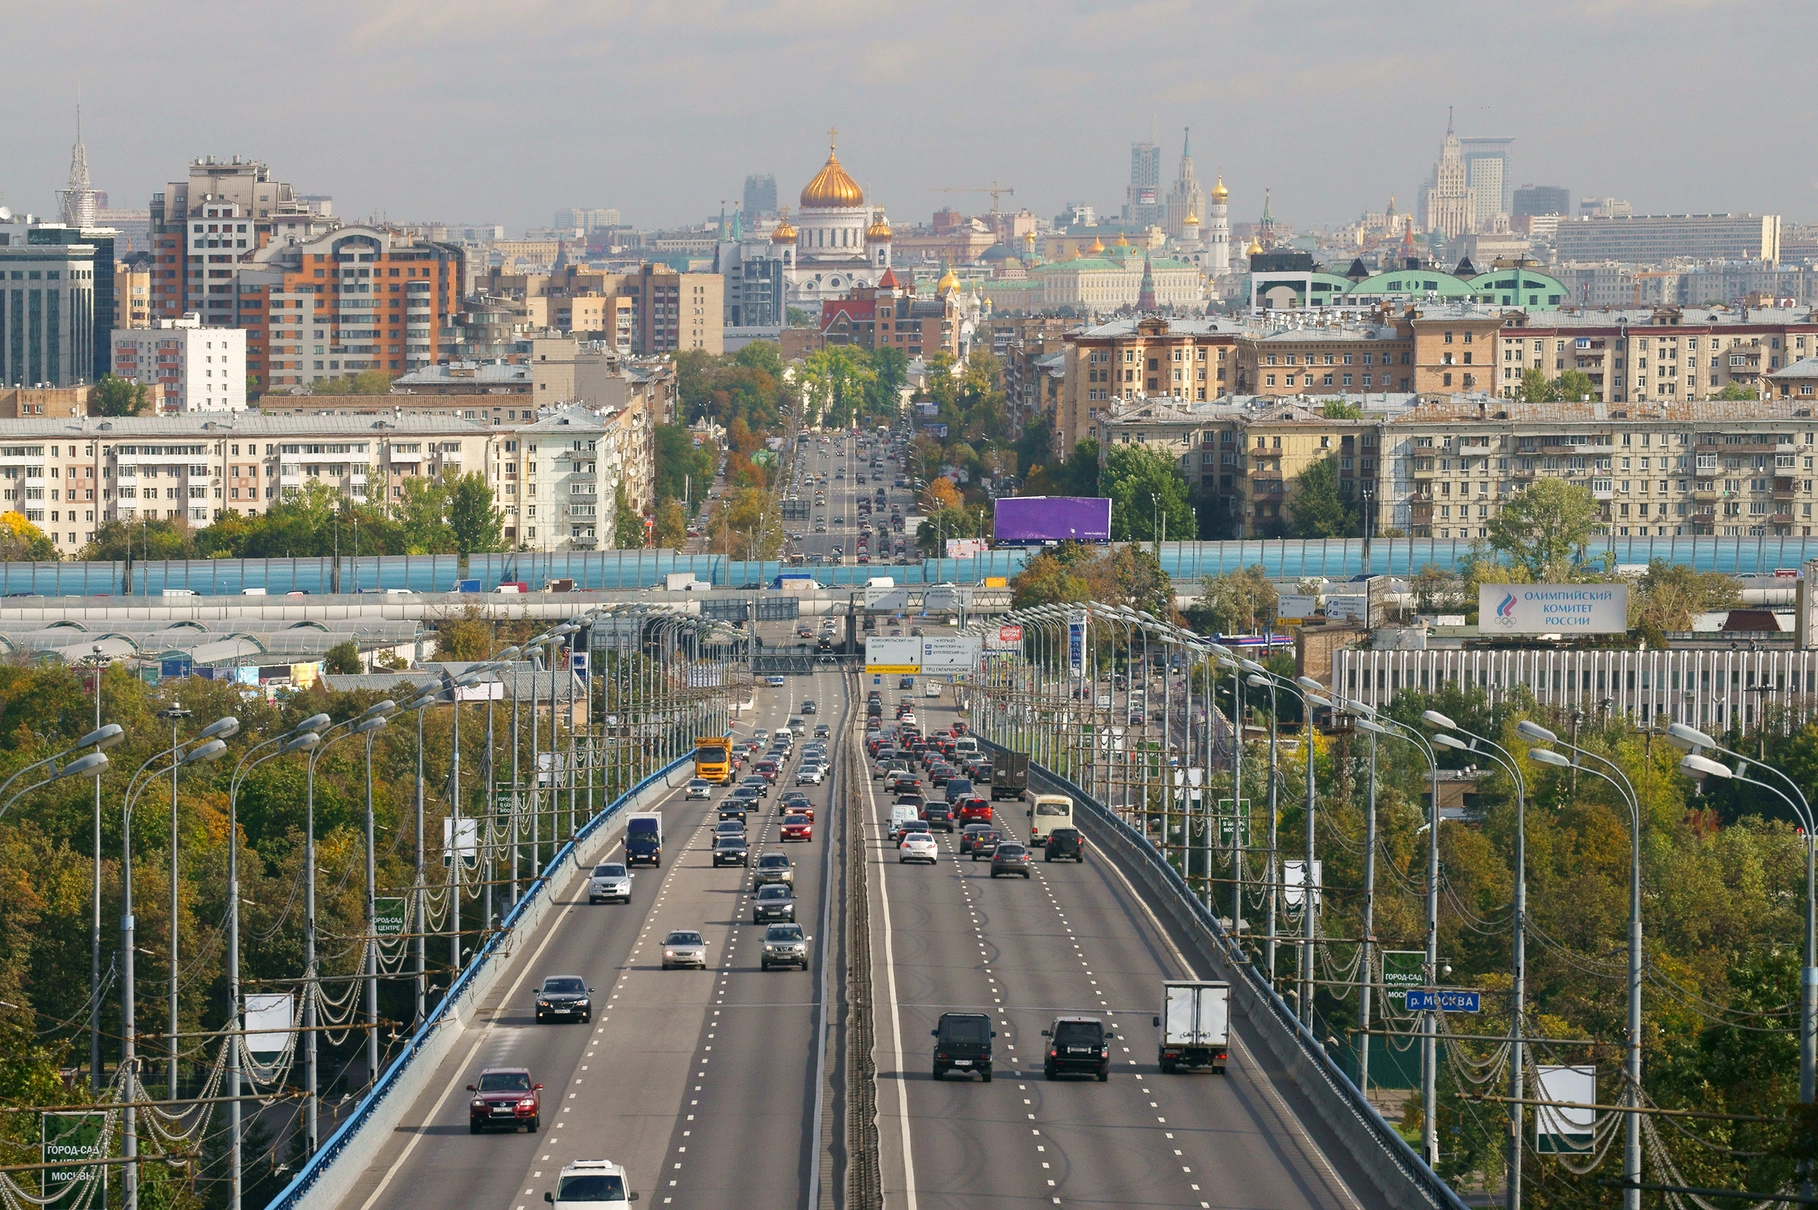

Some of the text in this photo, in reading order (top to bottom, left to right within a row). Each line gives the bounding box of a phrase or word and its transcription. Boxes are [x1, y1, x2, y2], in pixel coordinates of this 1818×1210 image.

[1524, 591, 1612, 601] ОЛИМПИЙСКИЙ
[1543, 604, 1593, 613] КОМИТЕТ
[1545, 616, 1590, 626] РОССИИ
[1385, 973, 1423, 982] ГОРОД-САД
[1410, 995, 1473, 1007] р. МОСКВА
[47, 1145, 100, 1156] ГОРОД-САД
